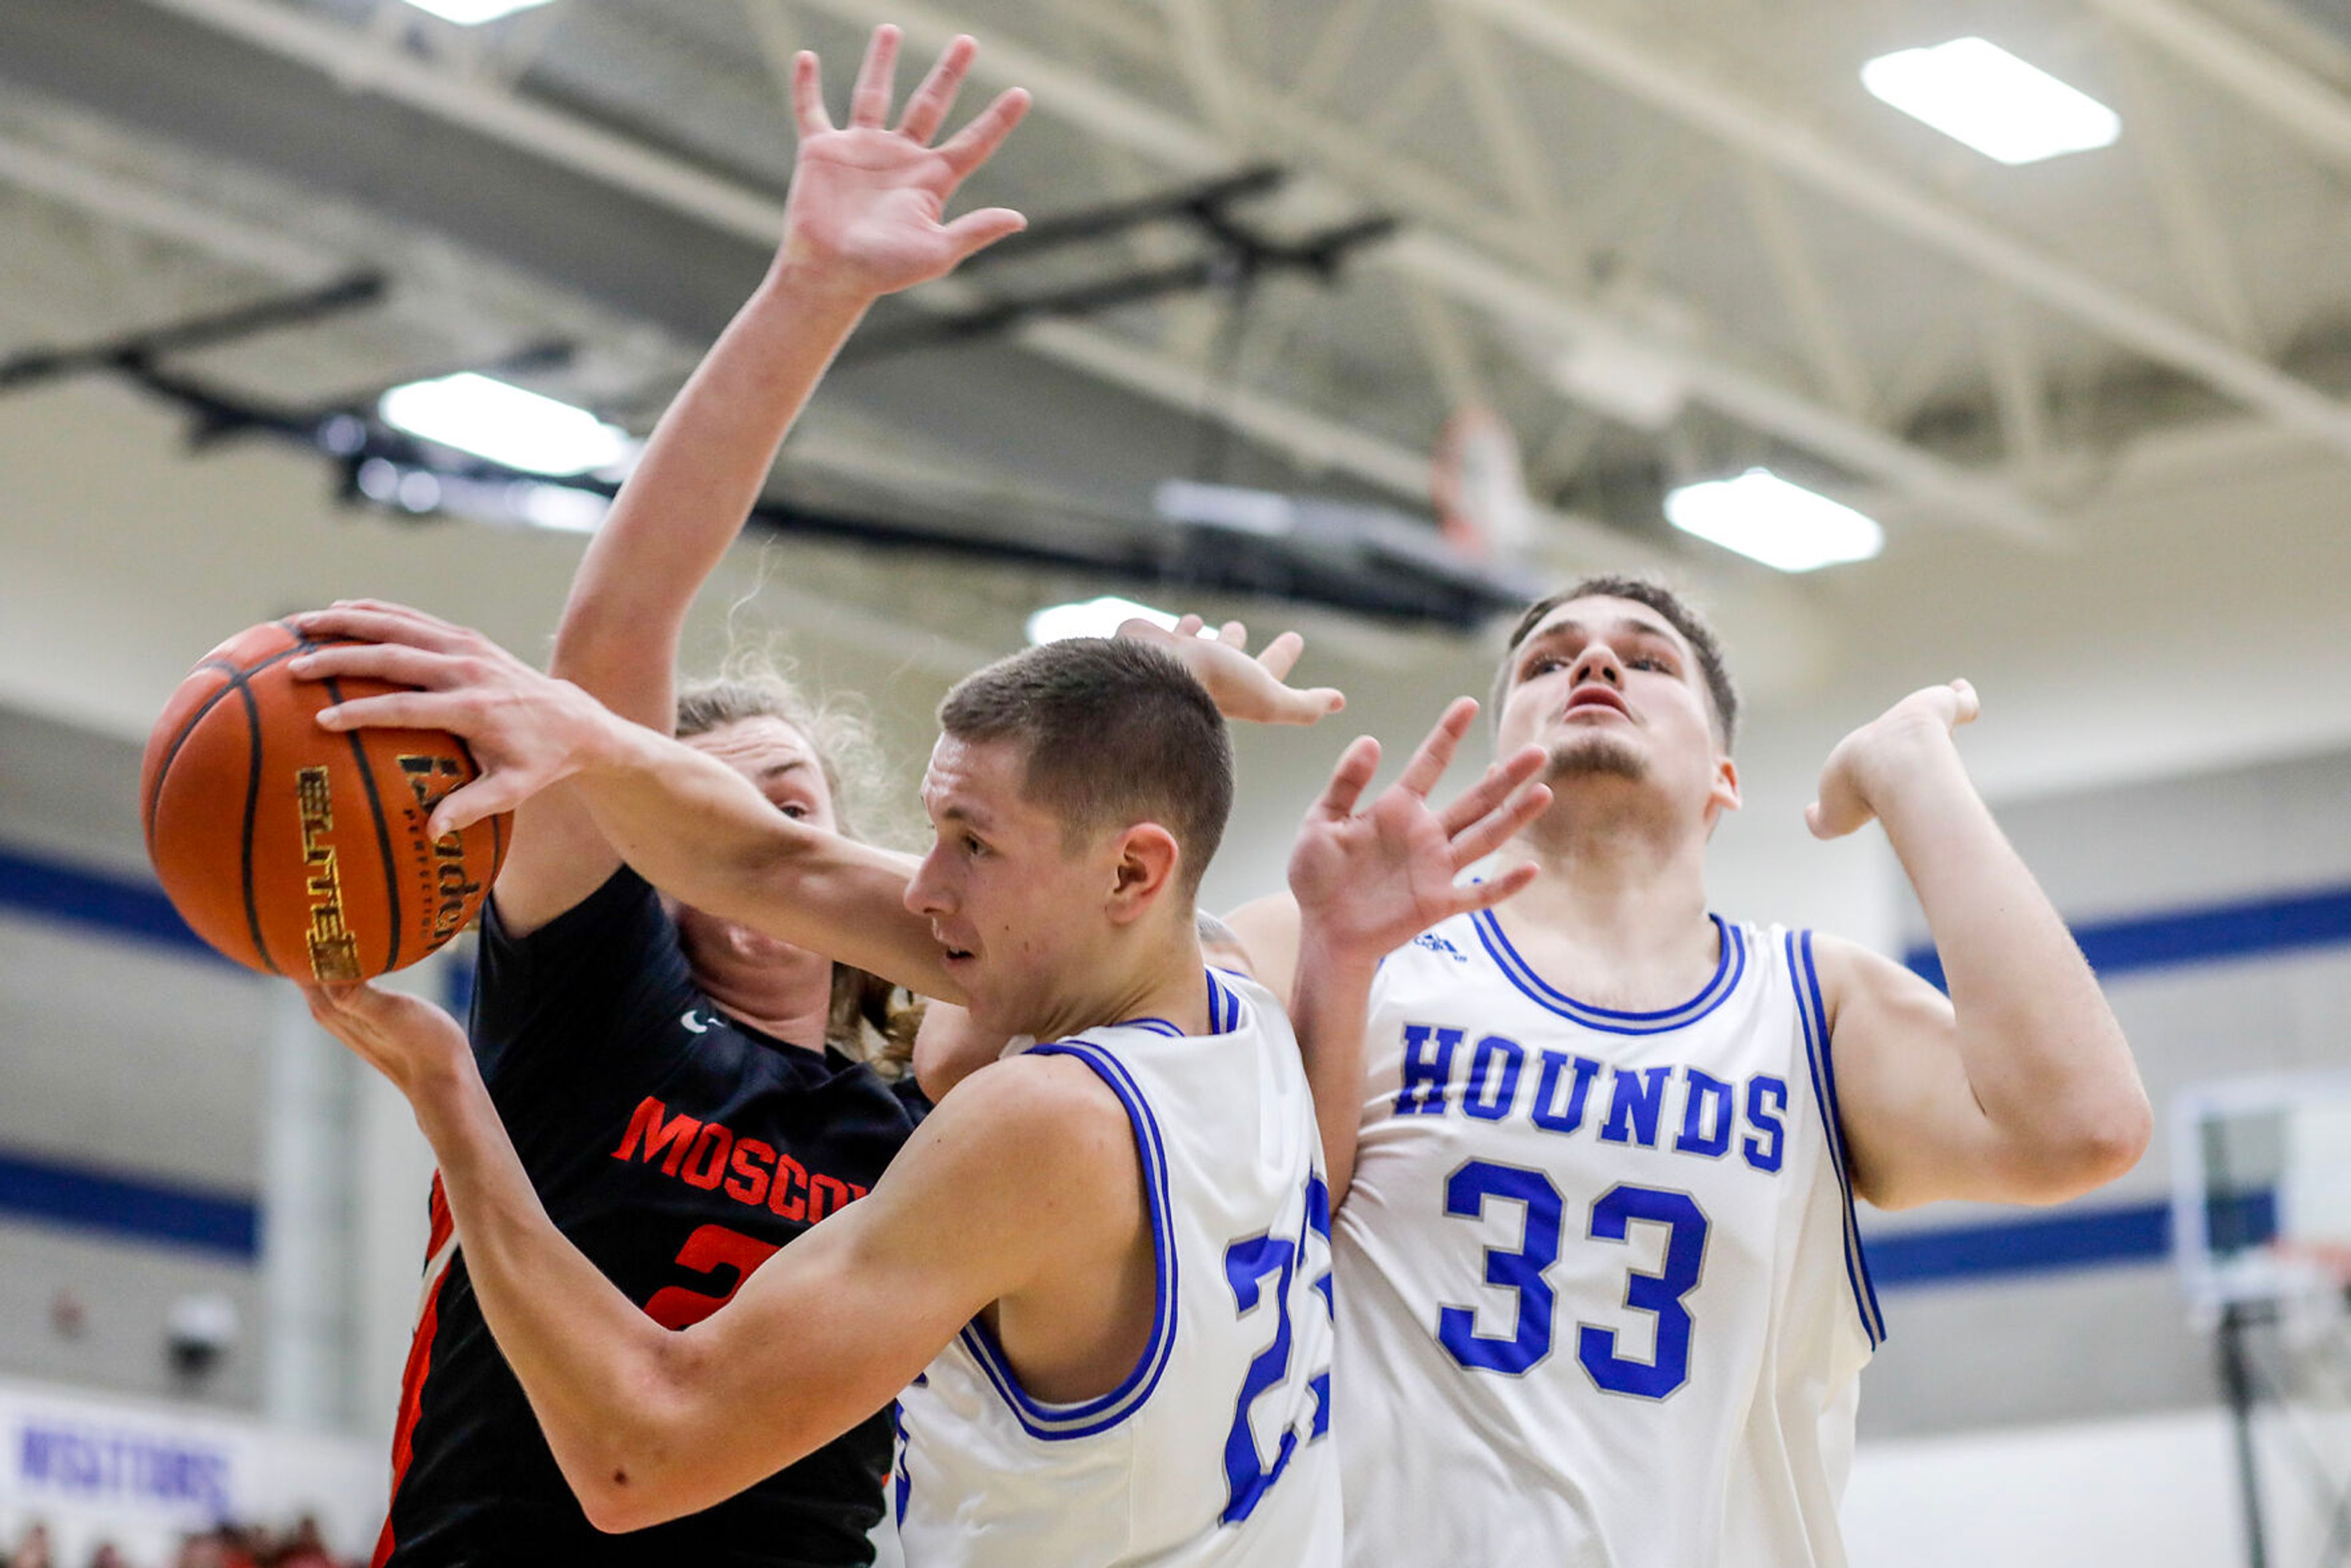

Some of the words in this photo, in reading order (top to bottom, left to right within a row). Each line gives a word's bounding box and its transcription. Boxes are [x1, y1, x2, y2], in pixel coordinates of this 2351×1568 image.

[296, 765, 346, 942] ELITE
[427, 830, 481, 952] aden
[611, 1095, 871, 1225] MOSCO
[1391, 1021, 1788, 1176] HOUNDS
[1434, 1157, 1713, 1403] 33
